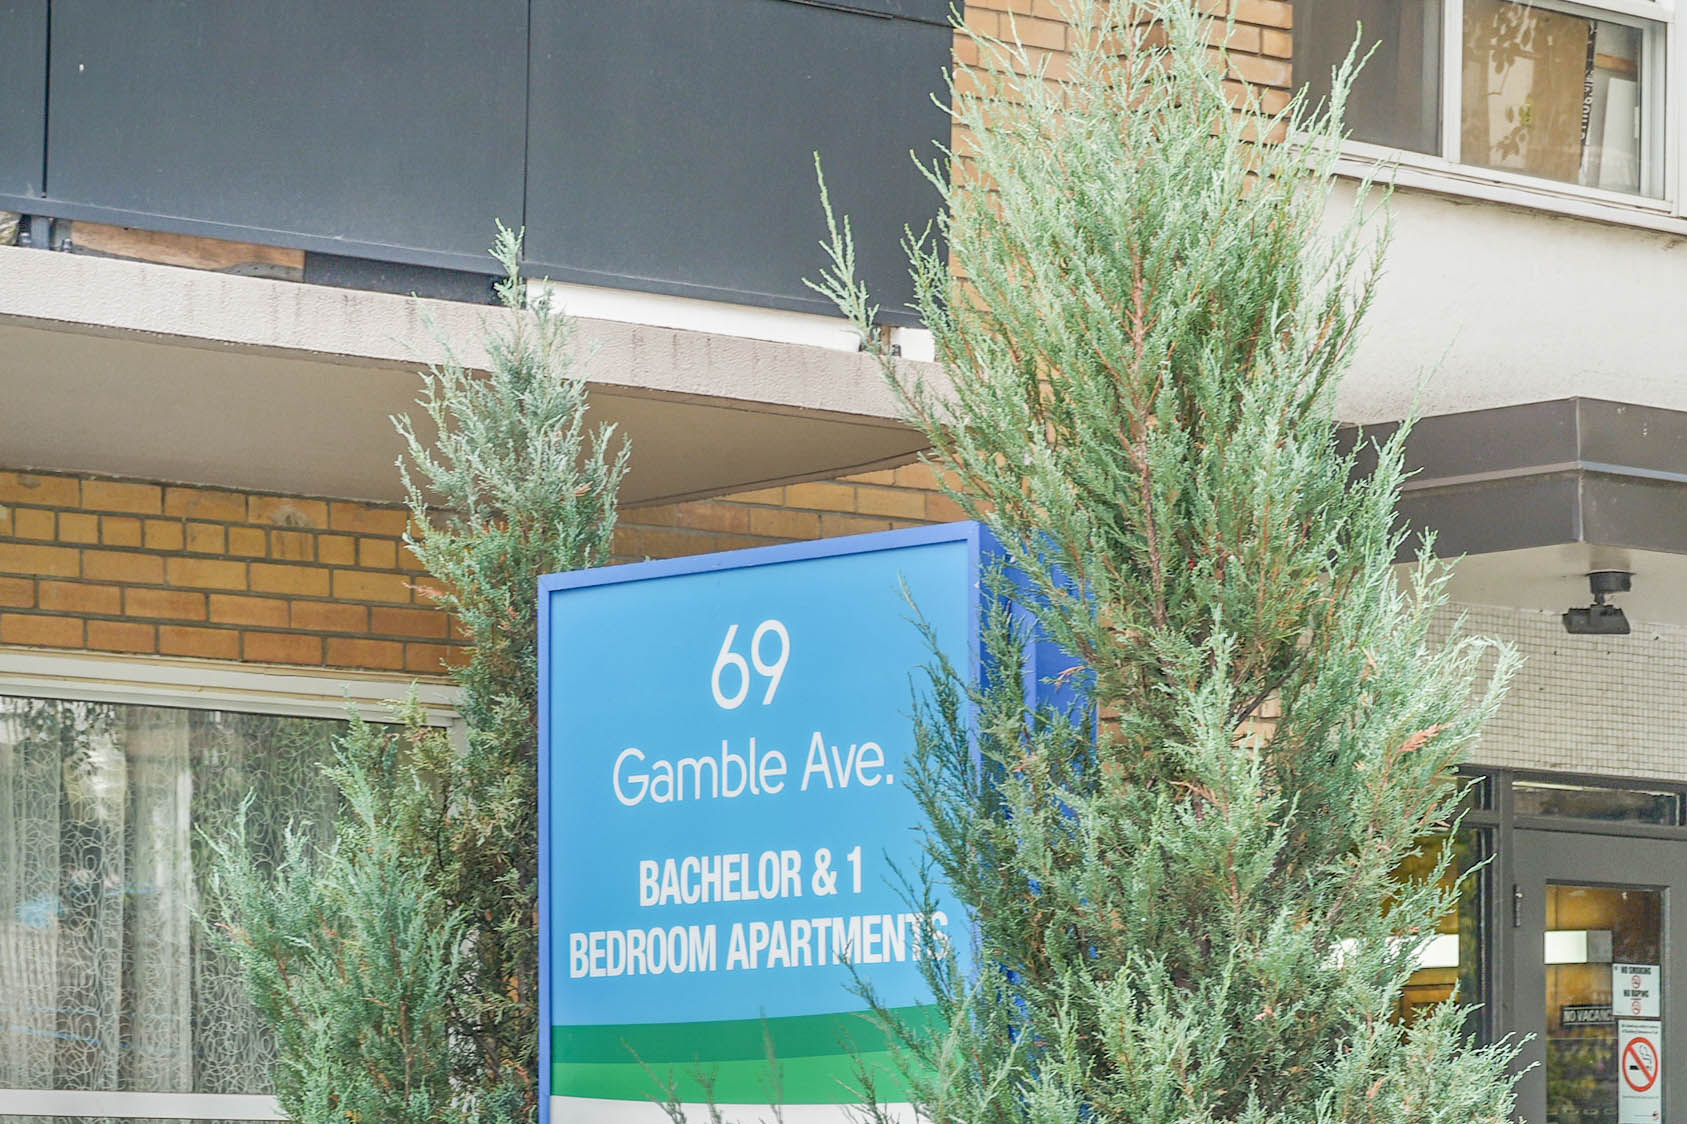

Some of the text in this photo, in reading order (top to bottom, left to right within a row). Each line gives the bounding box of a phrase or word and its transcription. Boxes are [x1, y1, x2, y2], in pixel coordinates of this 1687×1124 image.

[711, 619, 790, 710] 69
[612, 731, 893, 806] Gamble Ave.
[639, 846, 863, 907] BACHELOR & 1
[569, 911, 949, 979] BEDROOM APARTMENTS
